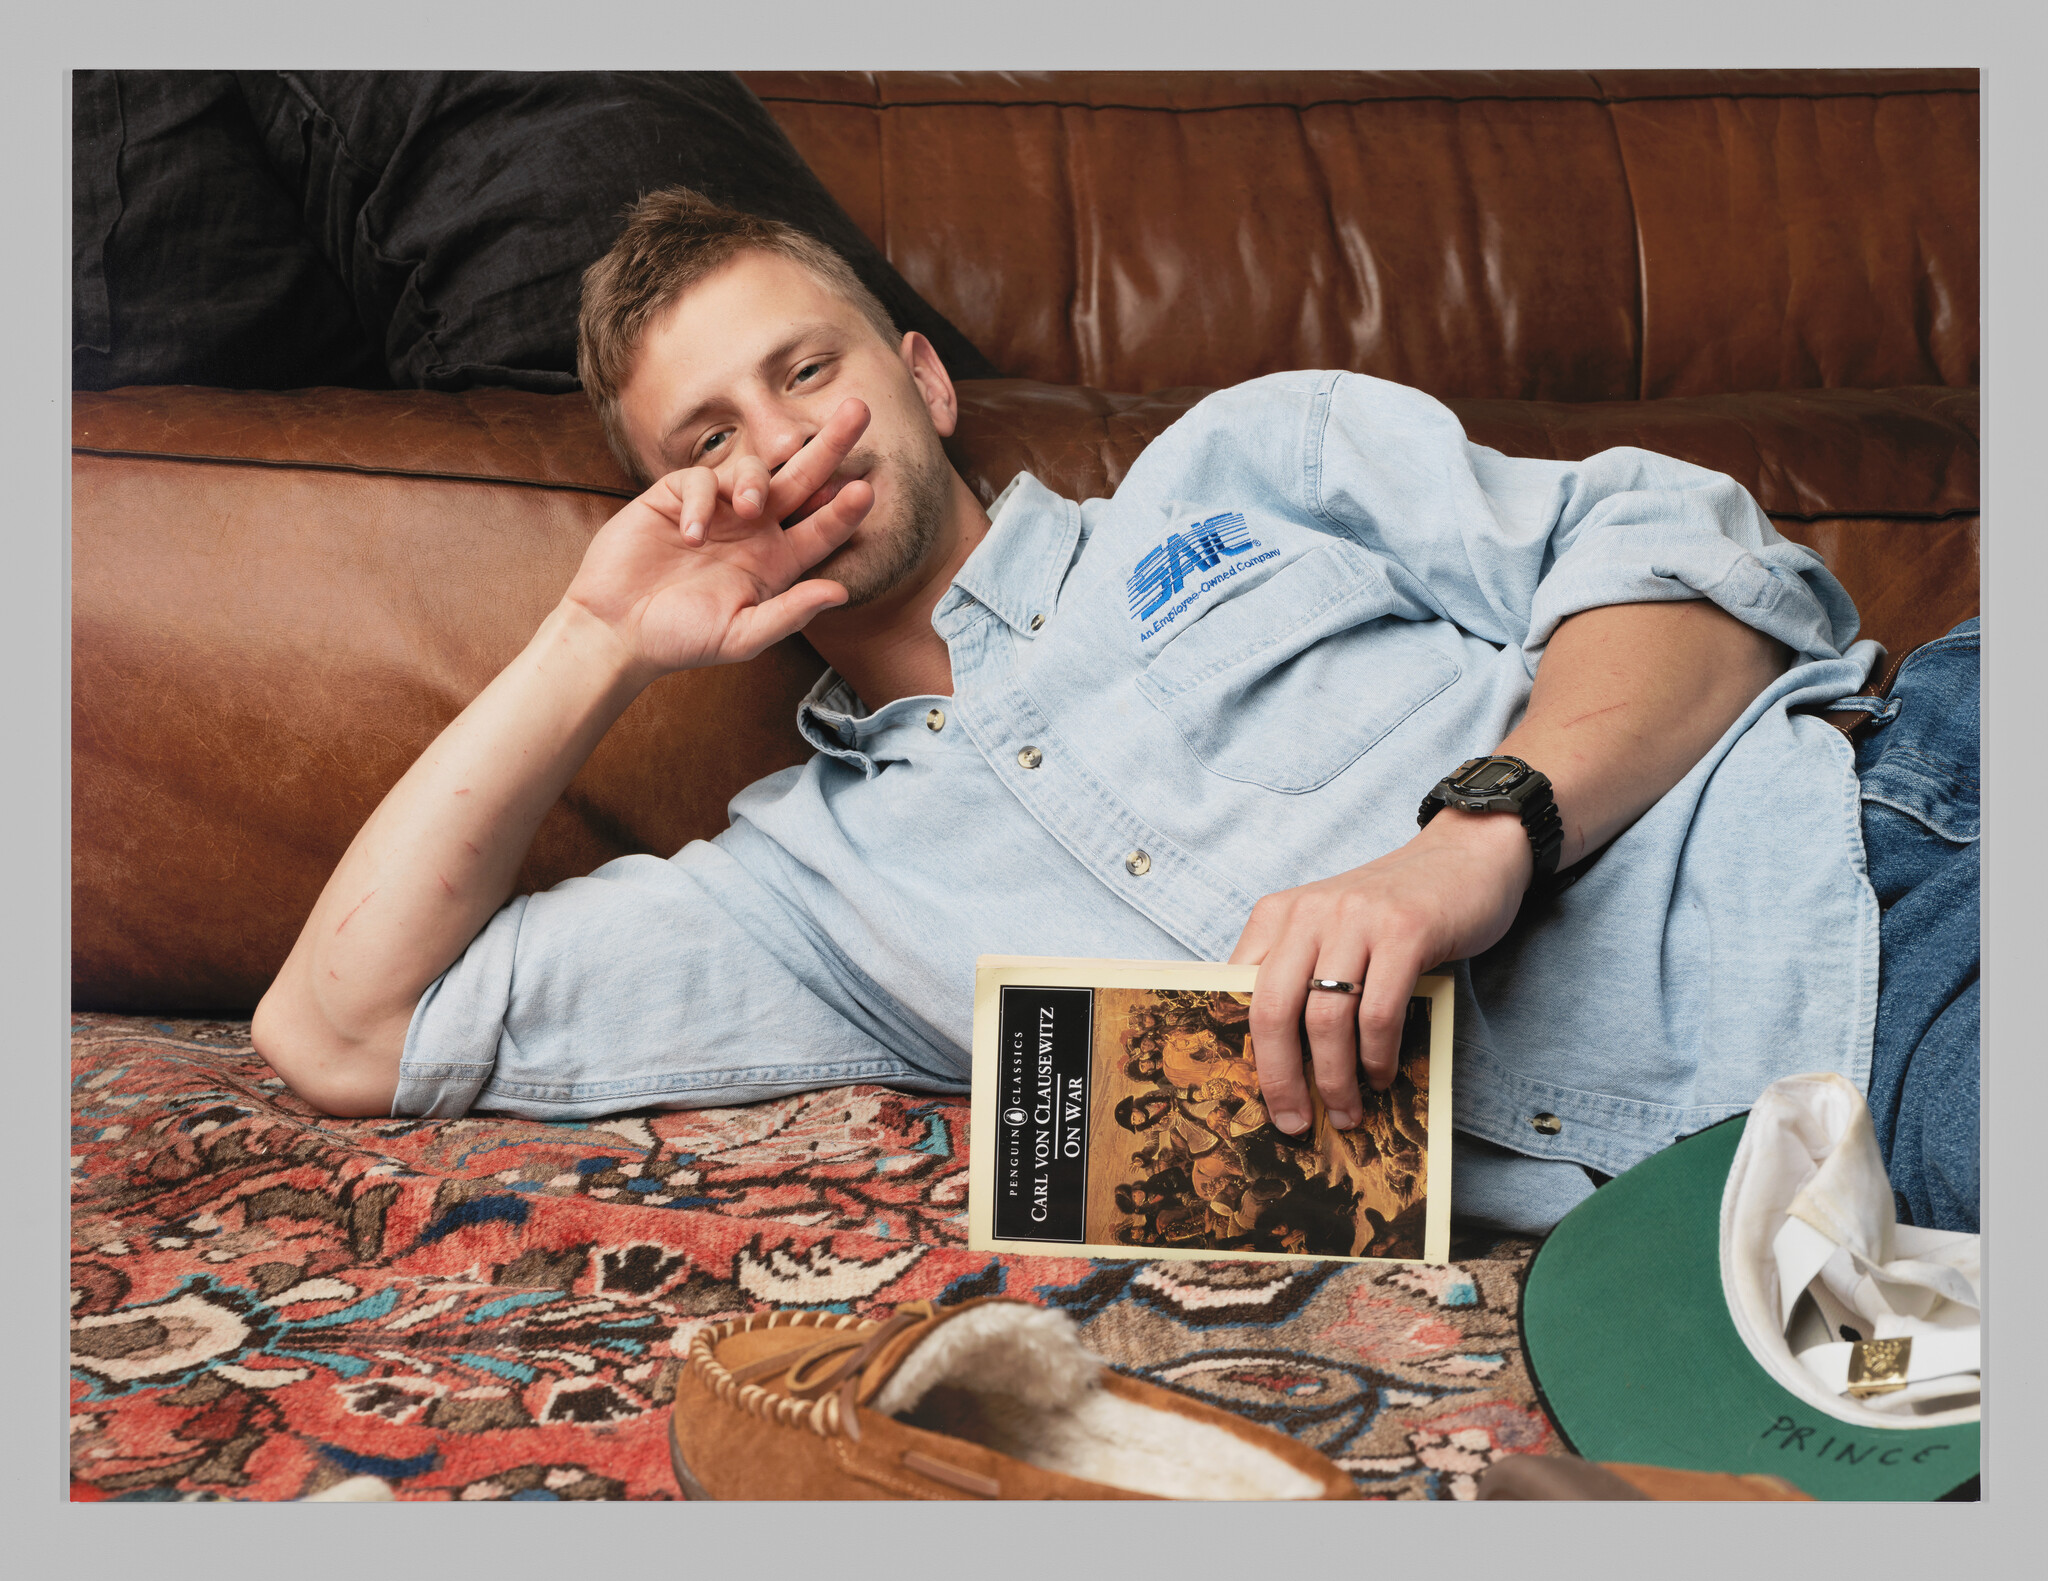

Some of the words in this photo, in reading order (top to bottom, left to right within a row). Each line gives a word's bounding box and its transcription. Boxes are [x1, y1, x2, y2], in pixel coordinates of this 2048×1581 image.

[1140, 630, 1153, 643] An
[1152, 565, 1237, 633] Employee-Owned
[1236, 548, 1281, 573] Company
[1011, 1031, 1023, 1104] CLASSICS
[1034, 1006, 1054, 1125] CLAUSEWITZ
[1065, 1076, 1083, 1122] WAR
[1009, 1129, 1020, 1196] PENGUIN
[1035, 1130, 1050, 1169] VON
[1064, 1127, 1081, 1158] ON
[1031, 1174, 1048, 1222] CARL
[1761, 1415, 1950, 1466] PRINCE
